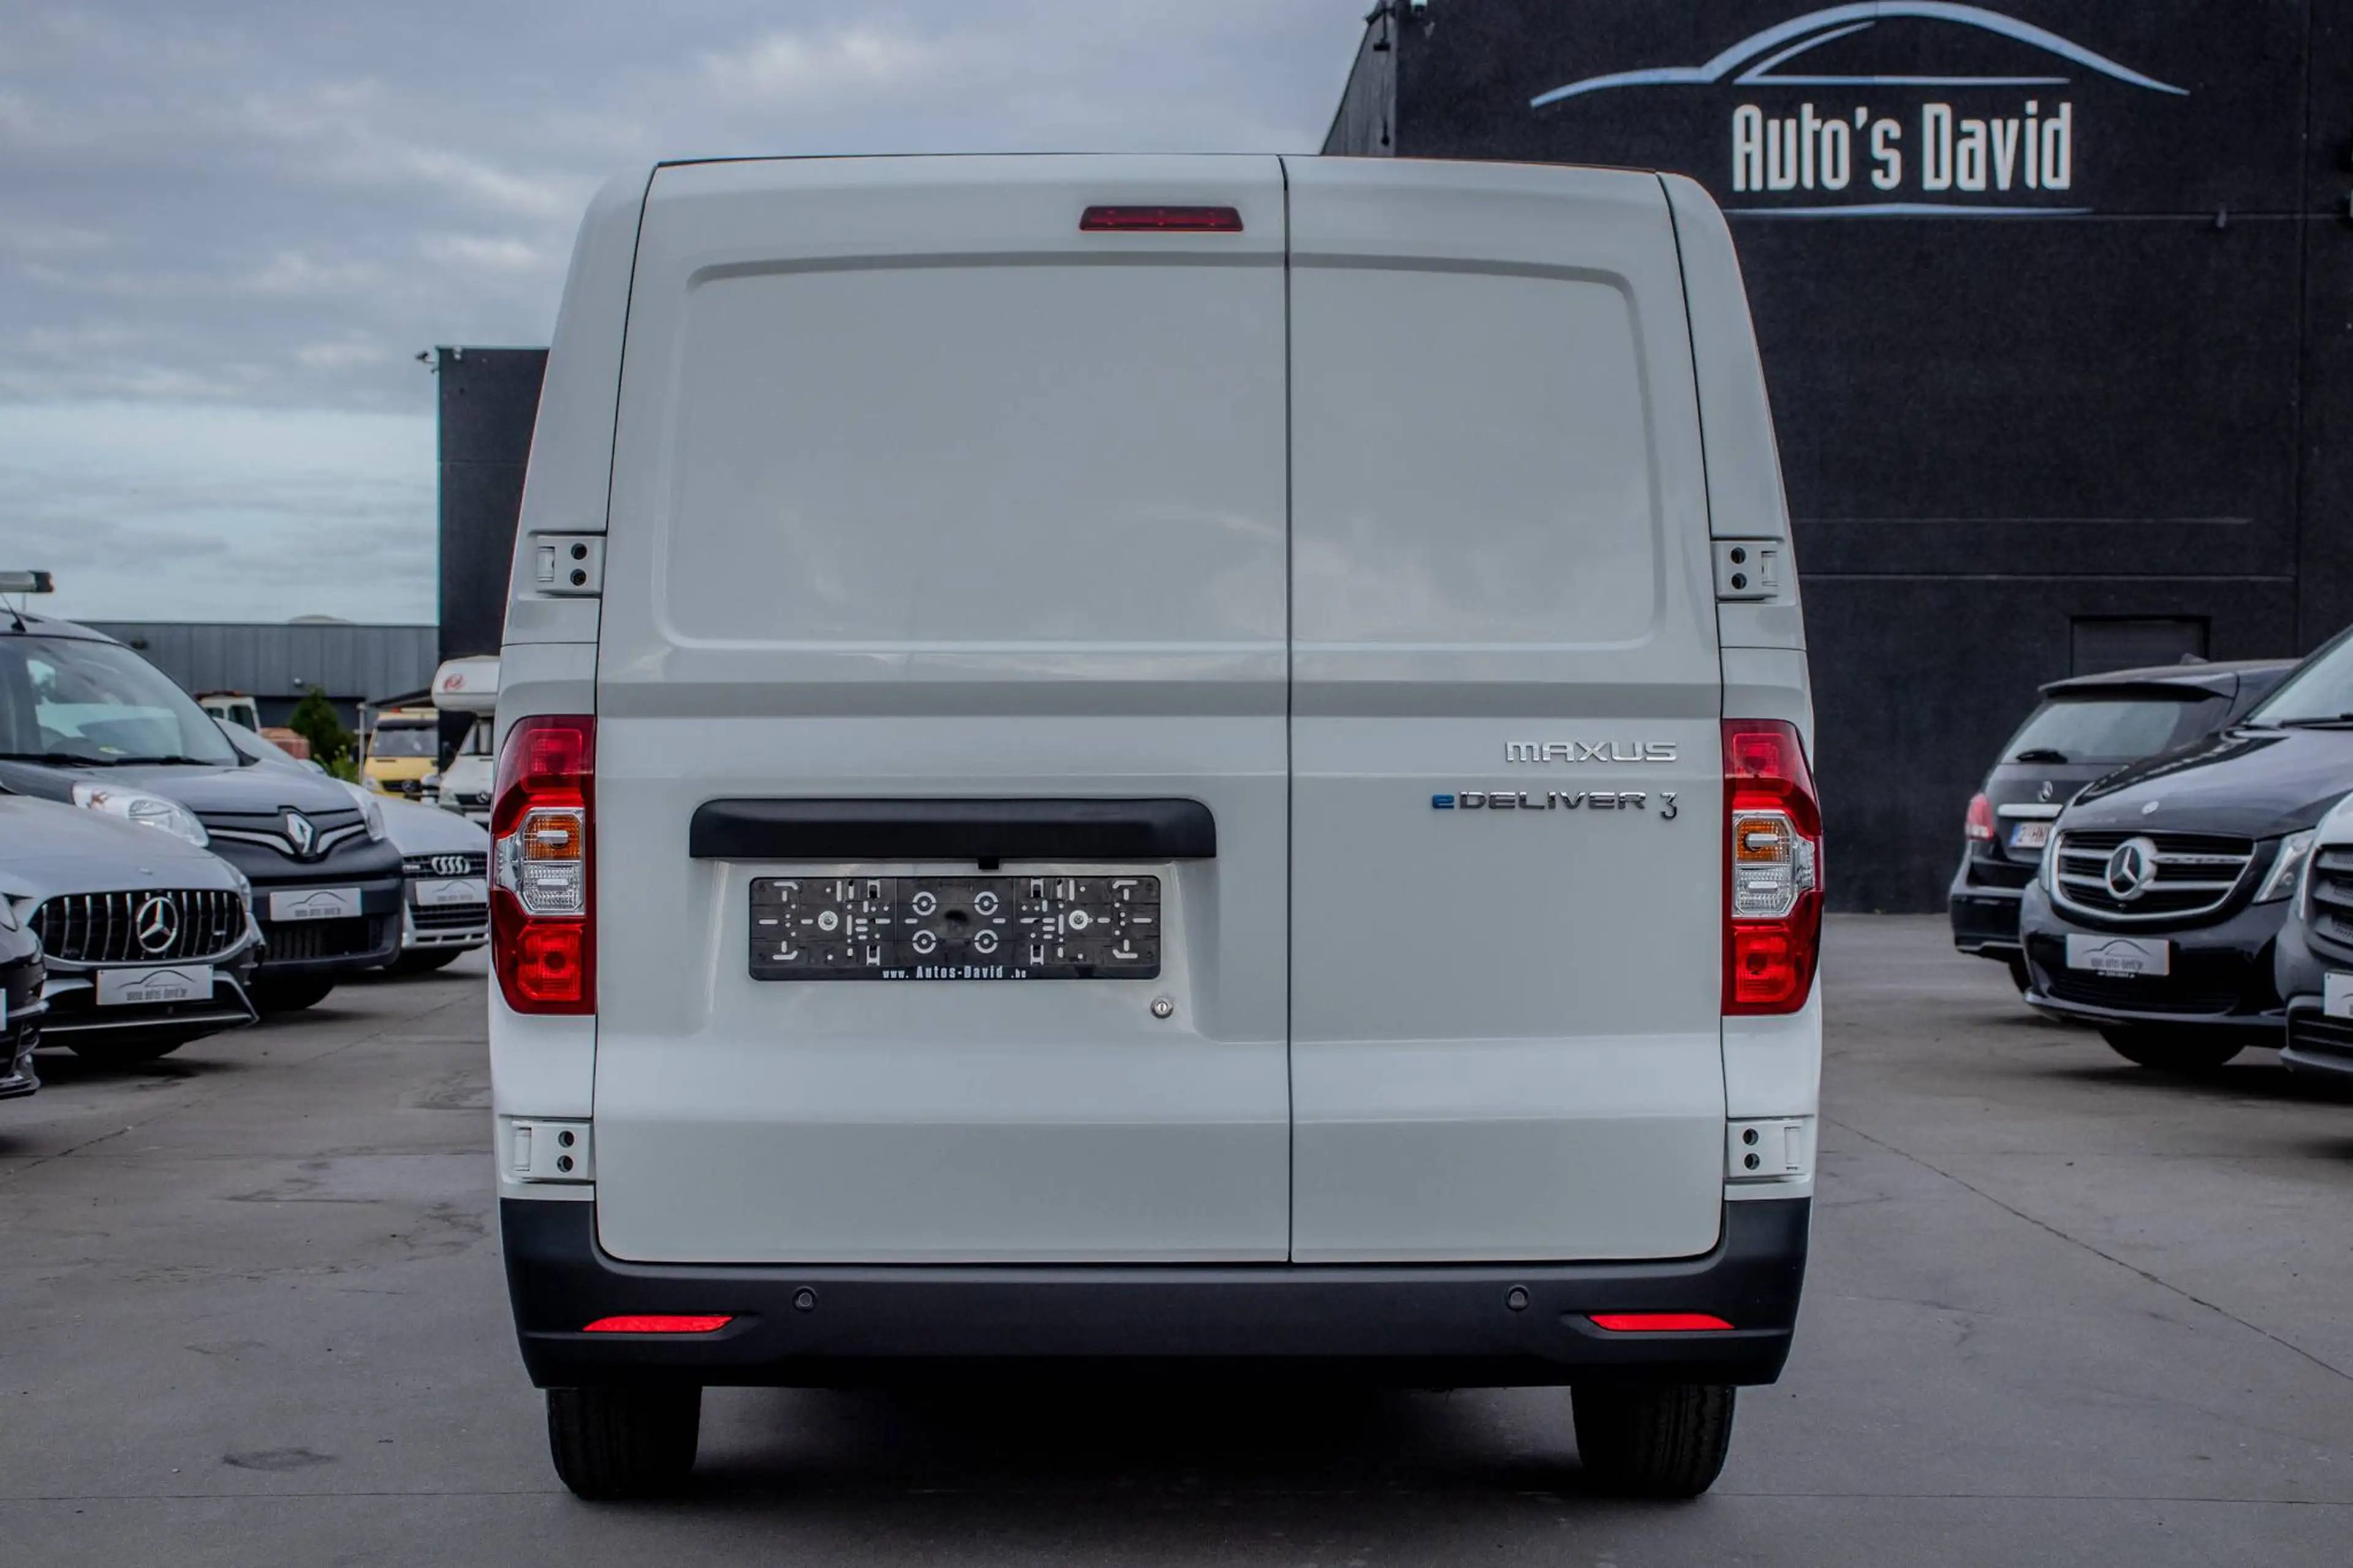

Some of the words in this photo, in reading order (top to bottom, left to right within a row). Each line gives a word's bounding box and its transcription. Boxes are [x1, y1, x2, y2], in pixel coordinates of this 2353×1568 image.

[1732, 102, 1901, 192] Auto's
[1922, 100, 2071, 192] David
[1506, 741, 1677, 762] MAXUS
[1431, 791, 1646, 809] eDELIVER
[1659, 791, 1678, 820] 3
[915, 965, 1003, 979] Autos-David
